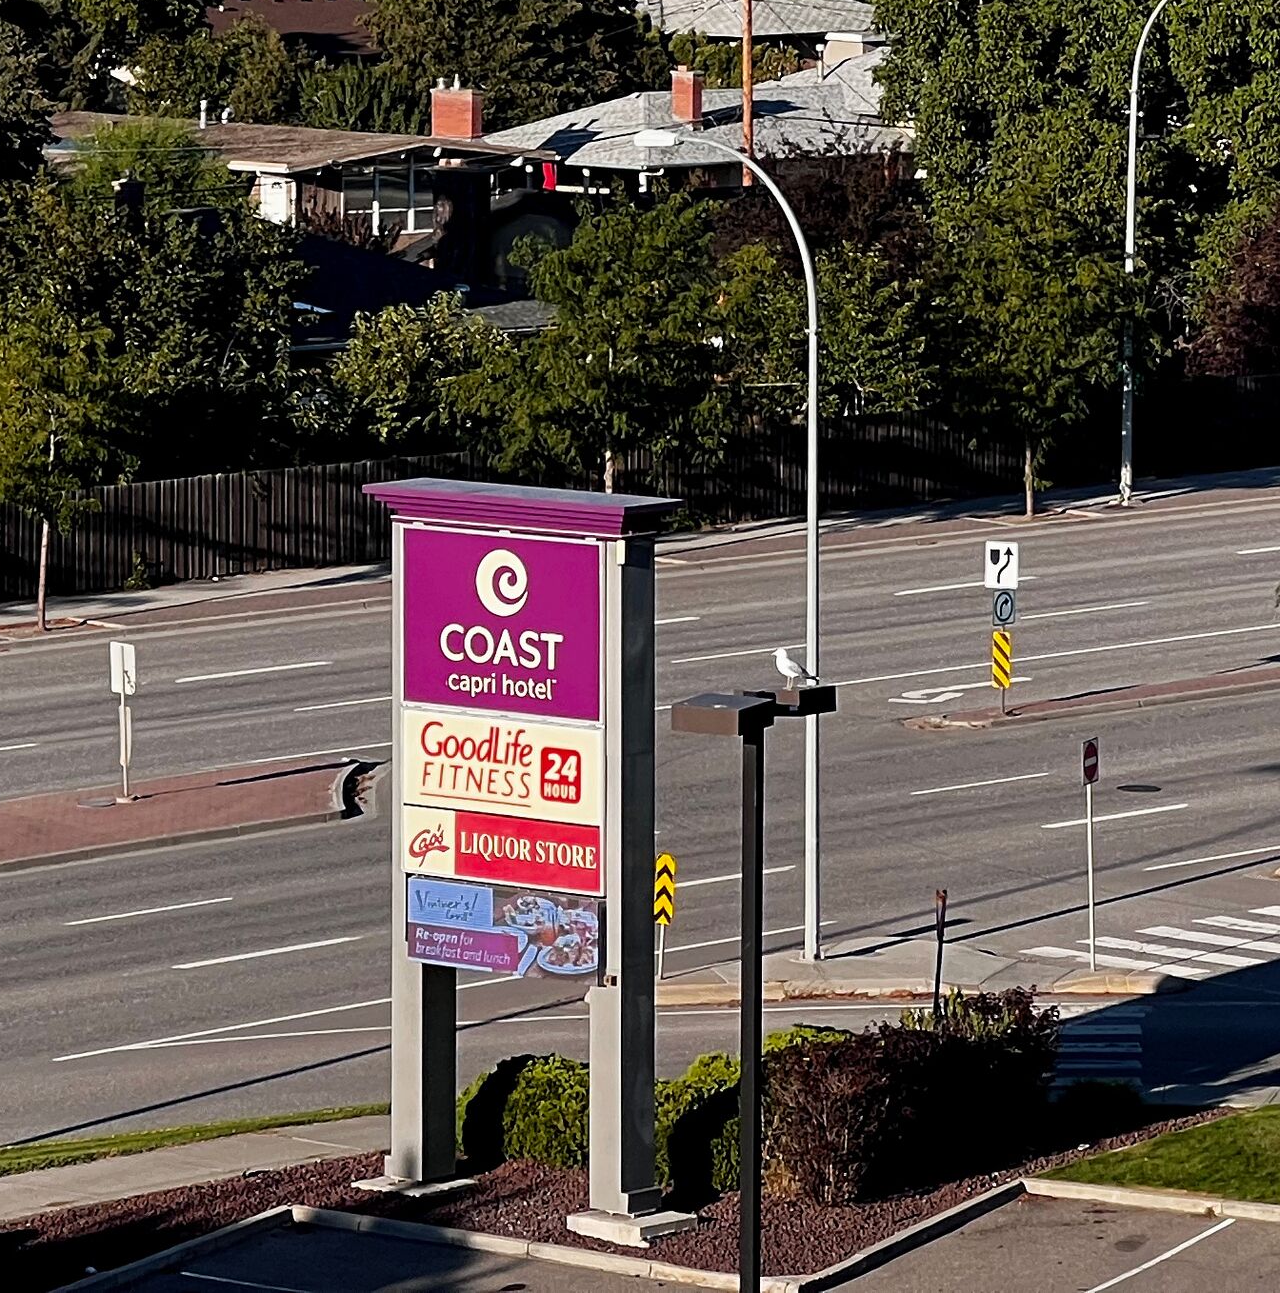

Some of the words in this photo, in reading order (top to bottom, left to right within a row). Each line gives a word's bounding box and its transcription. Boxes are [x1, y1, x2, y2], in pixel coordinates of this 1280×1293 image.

[440, 623, 564, 670] COAST
[448, 672, 496, 697] capri
[502, 673, 552, 700] hotel
[421, 721, 532, 767] GoodLife
[422, 762, 531, 799] FITNESS
[544, 753, 577, 782] 24
[544, 783, 577, 800] HOUR
[460, 831, 531, 861] LIQUOR
[536, 840, 597, 869] STORE
[416, 927, 458, 944] Re-open
[460, 932, 473, 946] for
[416, 942, 460, 959] breakfast
[463, 950, 482, 961] and
[484, 952, 510, 965] lunch
